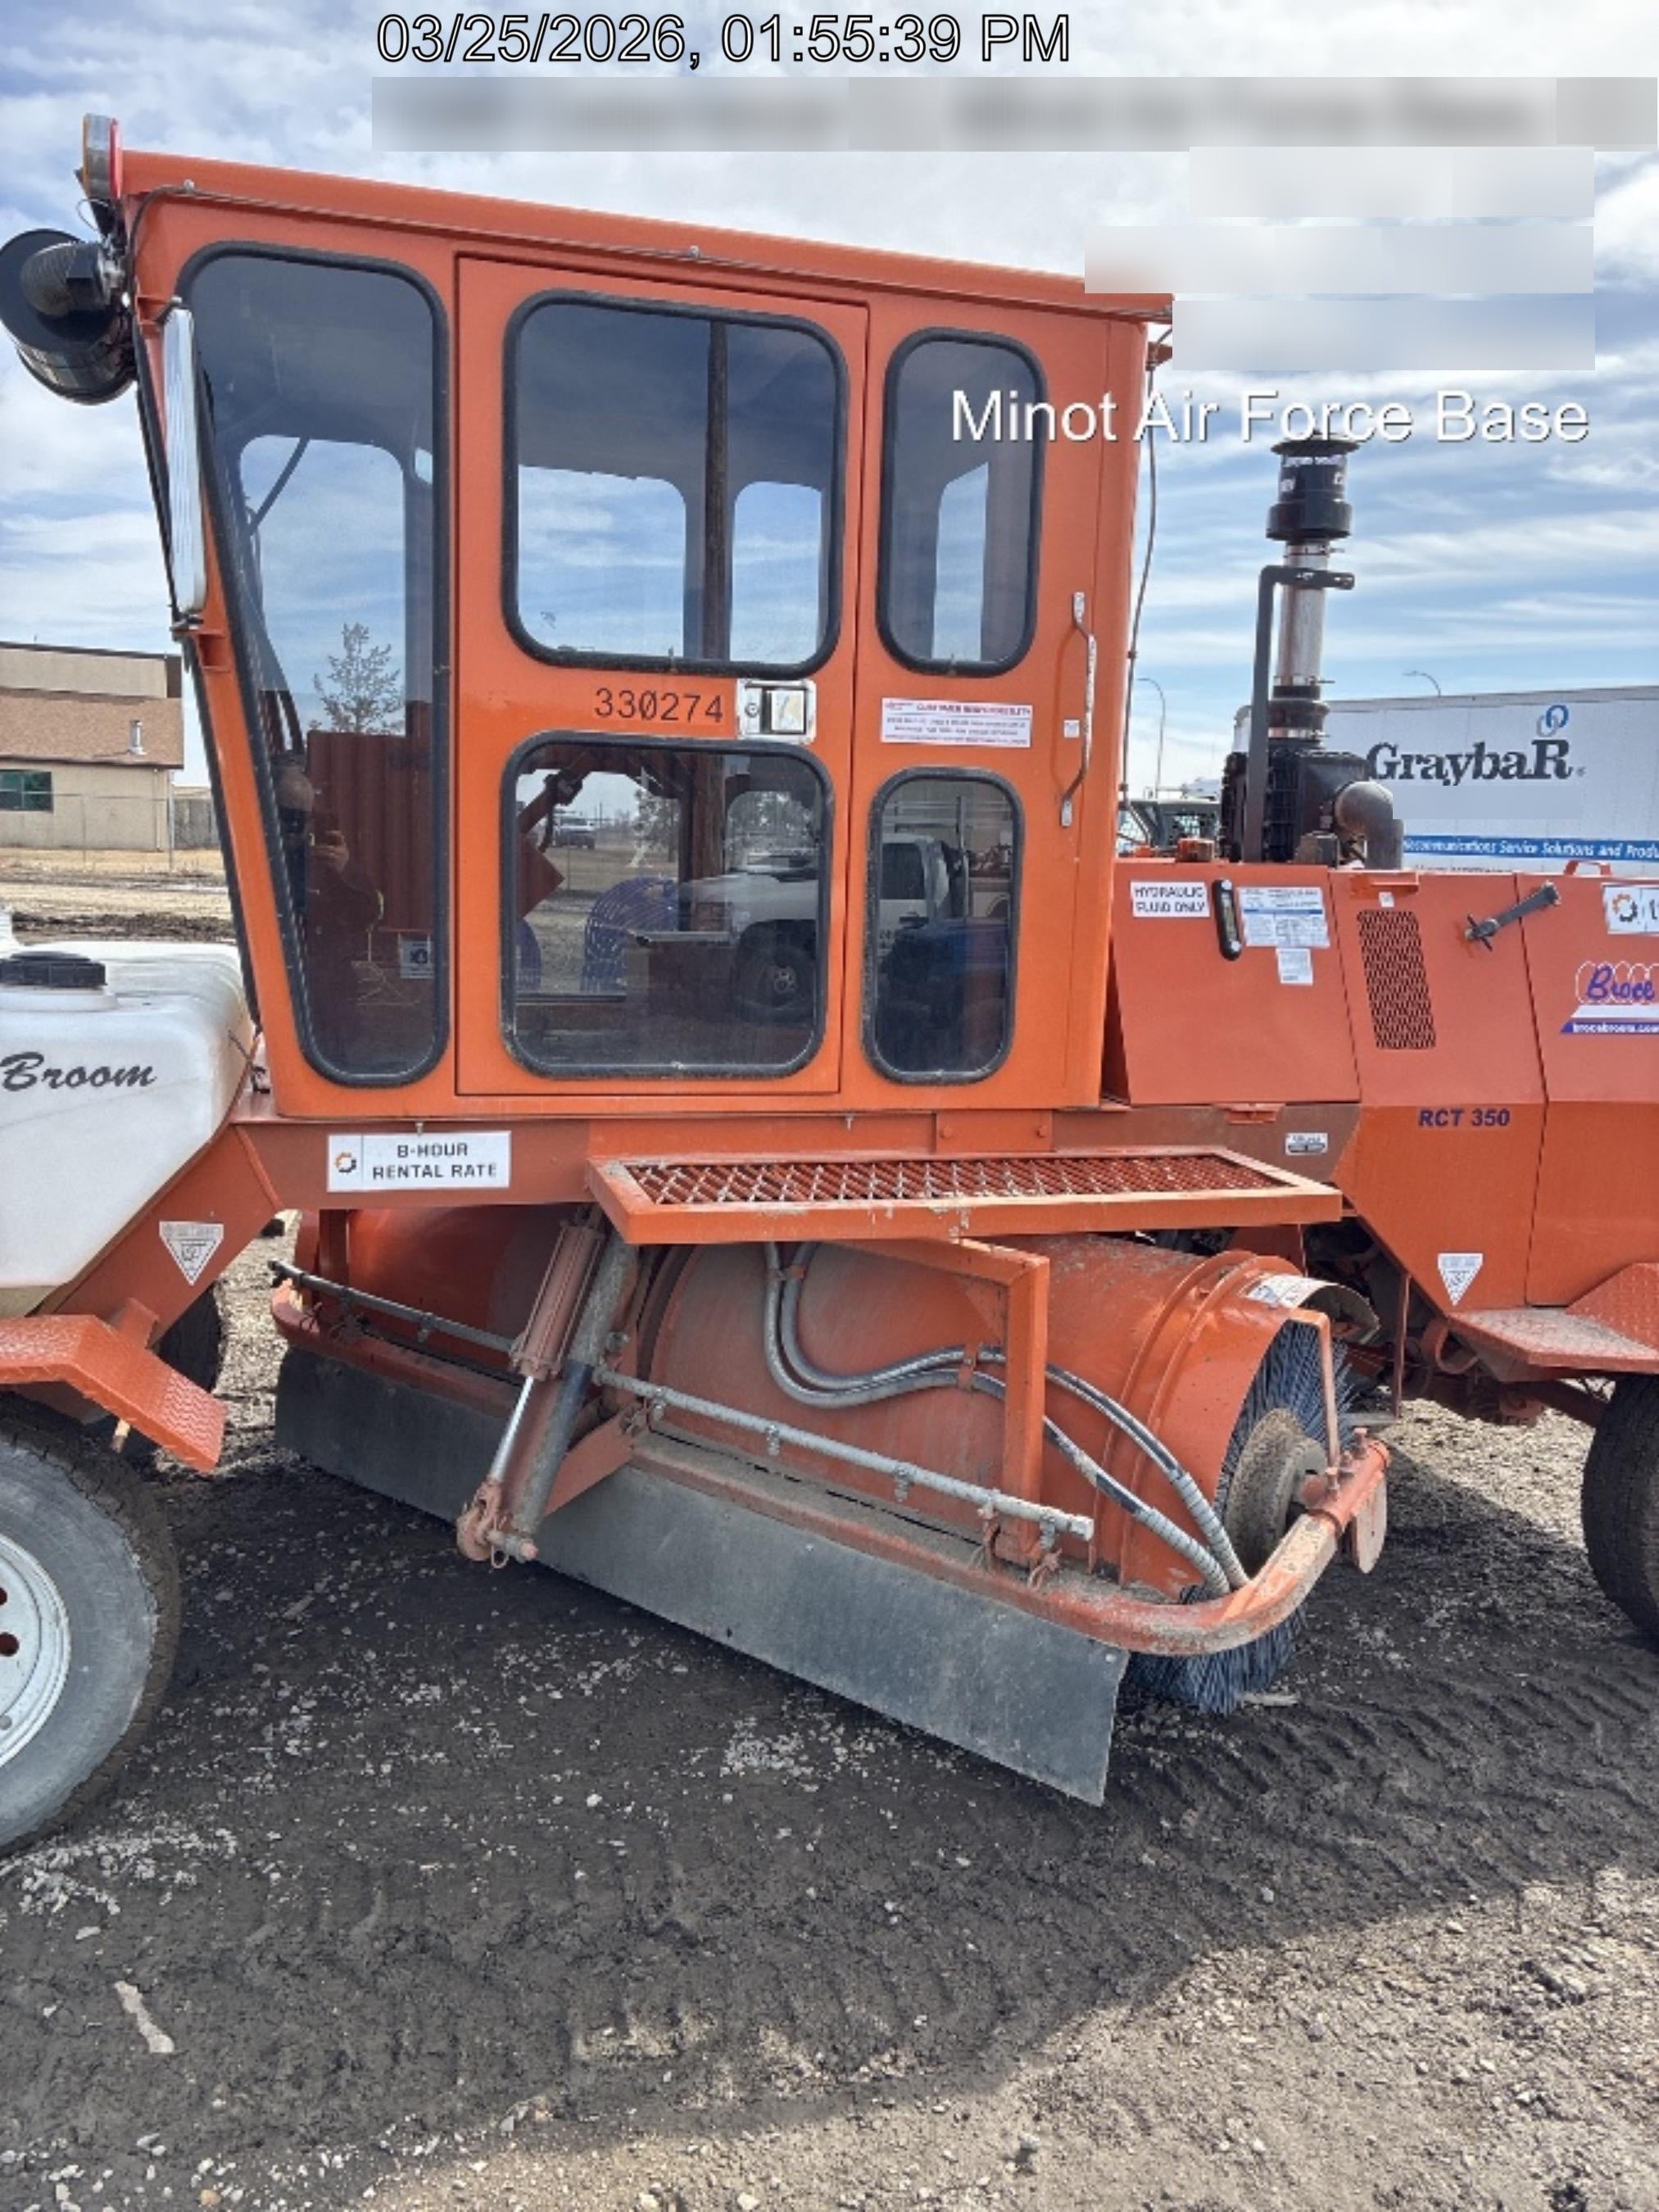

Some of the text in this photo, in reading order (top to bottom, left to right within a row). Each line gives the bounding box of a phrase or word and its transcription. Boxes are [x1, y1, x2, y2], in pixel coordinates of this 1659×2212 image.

[594, 687, 723, 723] 330274
[1498, 840, 1538, 854] Service
[1543, 841, 1593, 856] Solutions
[1598, 842, 1624, 857] and
[1134, 886, 1204, 898] HYDRAULIC
[1135, 902, 1205, 913] FLUID ONLY
[0, 1051, 157, 1091] Broom
[1418, 1108, 1510, 1127] RCT 350
[373, 1163, 496, 1180] RENTAL RATE
